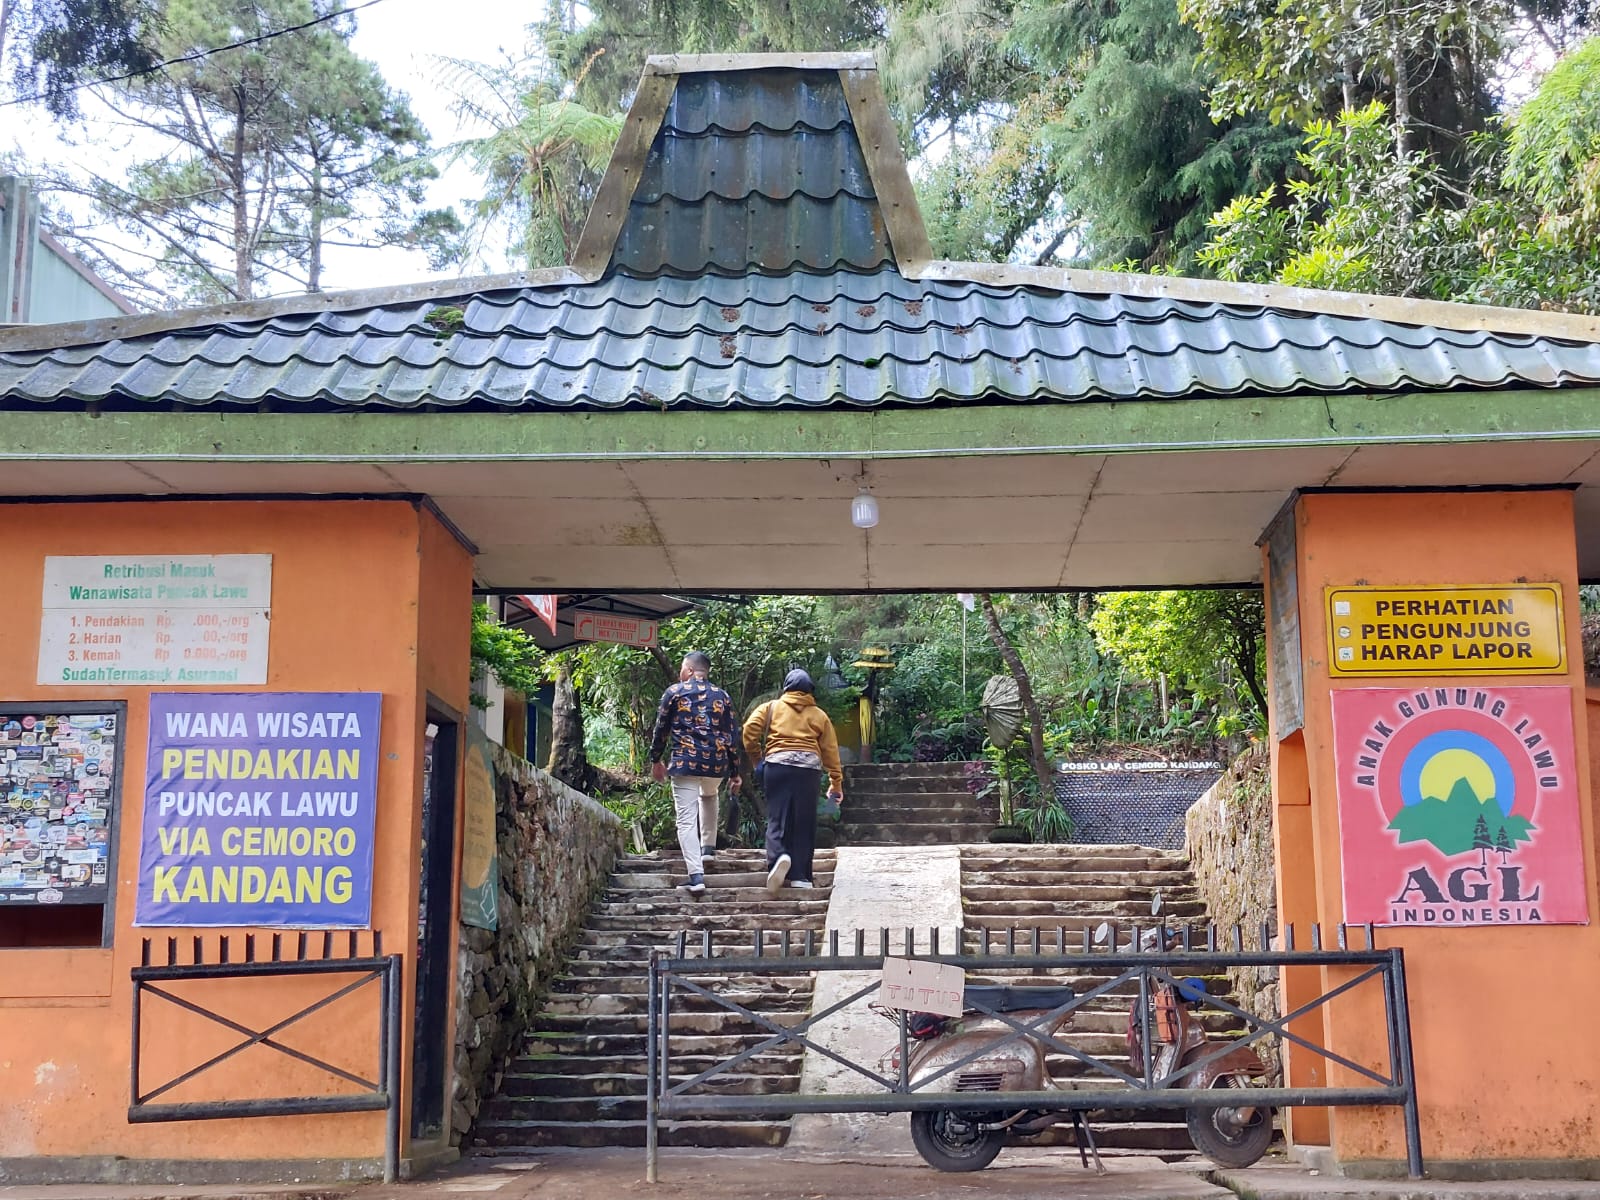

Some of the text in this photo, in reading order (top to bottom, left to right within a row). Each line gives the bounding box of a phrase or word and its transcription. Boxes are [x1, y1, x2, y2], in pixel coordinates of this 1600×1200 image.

[103, 563, 215, 579] Retribusi Masuk
[69, 585, 152, 600] Wanawisata
[213, 584, 248, 599] Lawu
[1376, 599, 1514, 617] PERHATIAN
[71, 615, 81, 628] 1.
[85, 615, 145, 628] Pendakian
[1361, 621, 1531, 640] PENGUNJUNG
[69, 632, 80, 645] 2.
[83, 632, 122, 645] Harian
[68, 649, 79, 661] 3.
[82, 649, 120, 661] Kemah
[1361, 642, 1533, 661] HARAP LAPOR
[177, 667, 239, 682] Asuransi
[166, 712, 361, 738] WANA WISATA
[1357, 688, 1558, 788] ANAK GUNUNG LAWU
[161, 749, 360, 780] PENDAKIAN
[1061, 762, 1099, 770] POSKO
[1124, 761, 1168, 770] CEMORO
[1170, 761, 1221, 769] KANDANG
[159, 791, 359, 817] PUNCAK LAWU
[157, 827, 356, 857] VIA CEMORO
[152, 866, 353, 904] KANDANG
[1391, 866, 1540, 904] AGL
[1392, 908, 1542, 923] INDONESIA
